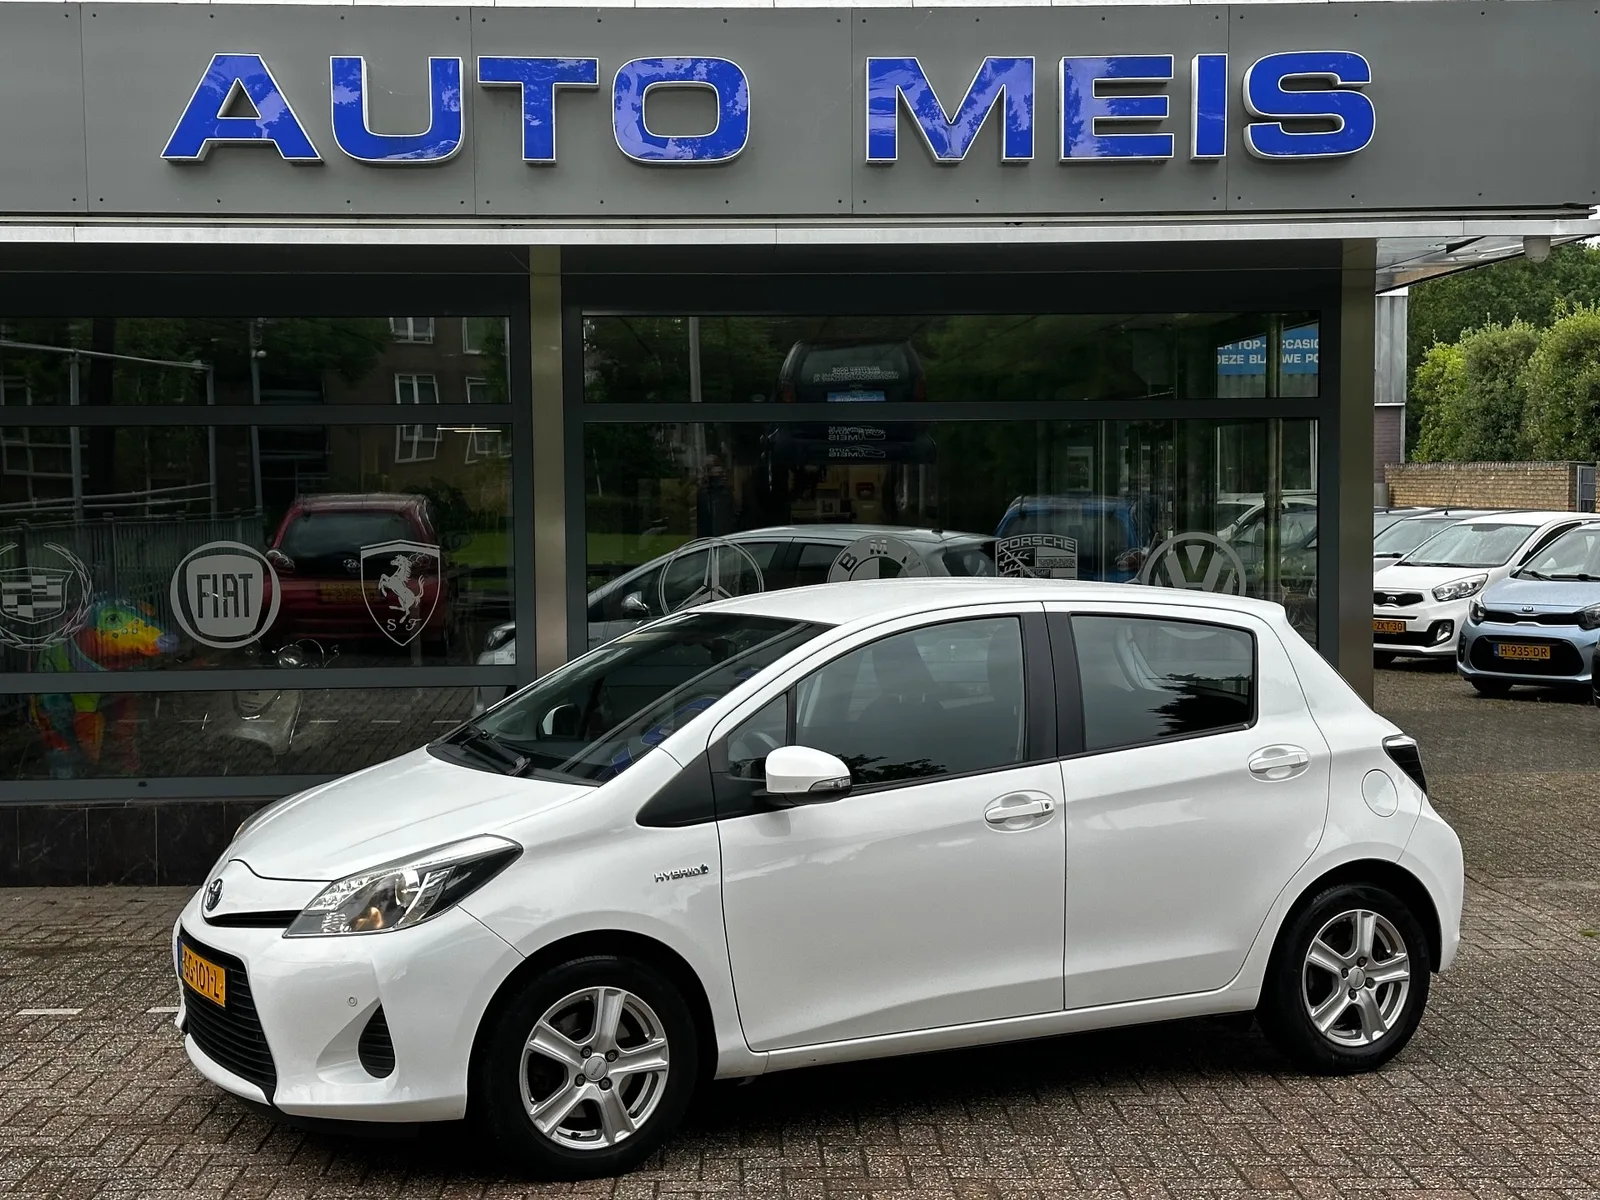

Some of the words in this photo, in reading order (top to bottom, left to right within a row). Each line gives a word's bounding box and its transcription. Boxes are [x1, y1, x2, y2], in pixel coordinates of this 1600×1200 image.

[160, 53, 751, 165] AUTO
[865, 51, 1376, 164] MEIS
[1249, 353, 1301, 364] BLWE
[998, 536, 1075, 552] PORSCHE
[196, 573, 254, 618] FIAT
[1374, 621, 1403, 631] -ZKT-30
[1500, 645, 1547, 657] H-935-DR
[654, 867, 701, 882] HYBRID
